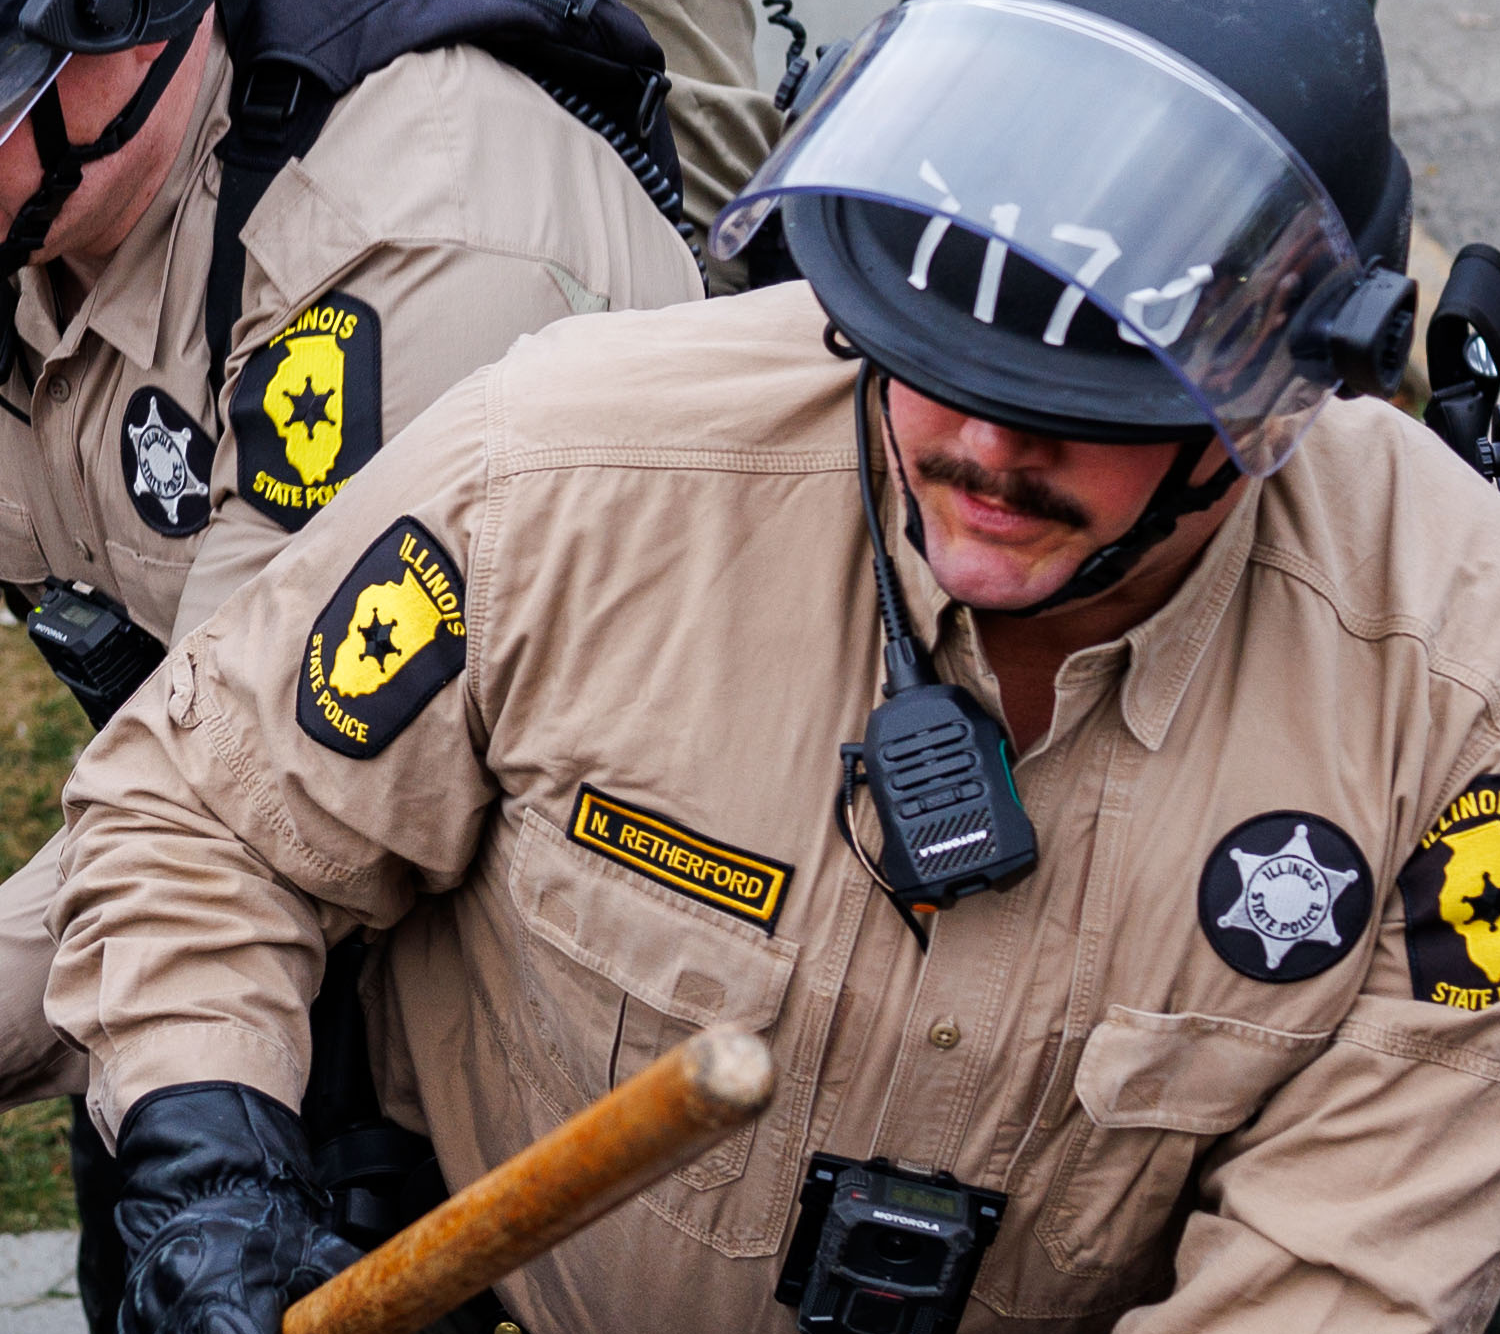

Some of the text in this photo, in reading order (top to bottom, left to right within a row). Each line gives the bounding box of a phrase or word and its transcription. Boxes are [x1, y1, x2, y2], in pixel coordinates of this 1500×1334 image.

[253, 471, 355, 508] STATE POL
[399, 533, 465, 637] ILLINOIS
[310, 633, 370, 744] STATE POLICE
[590, 812, 764, 901] N. RETHERFORD
[919, 830, 987, 858] MOTOROLA
[1262, 858, 1324, 892] ILLINOIS
[1251, 892, 1324, 935] STATE POLICE
[1433, 981, 1493, 1009] STATE
[872, 1210, 940, 1232] MOTOROLA
